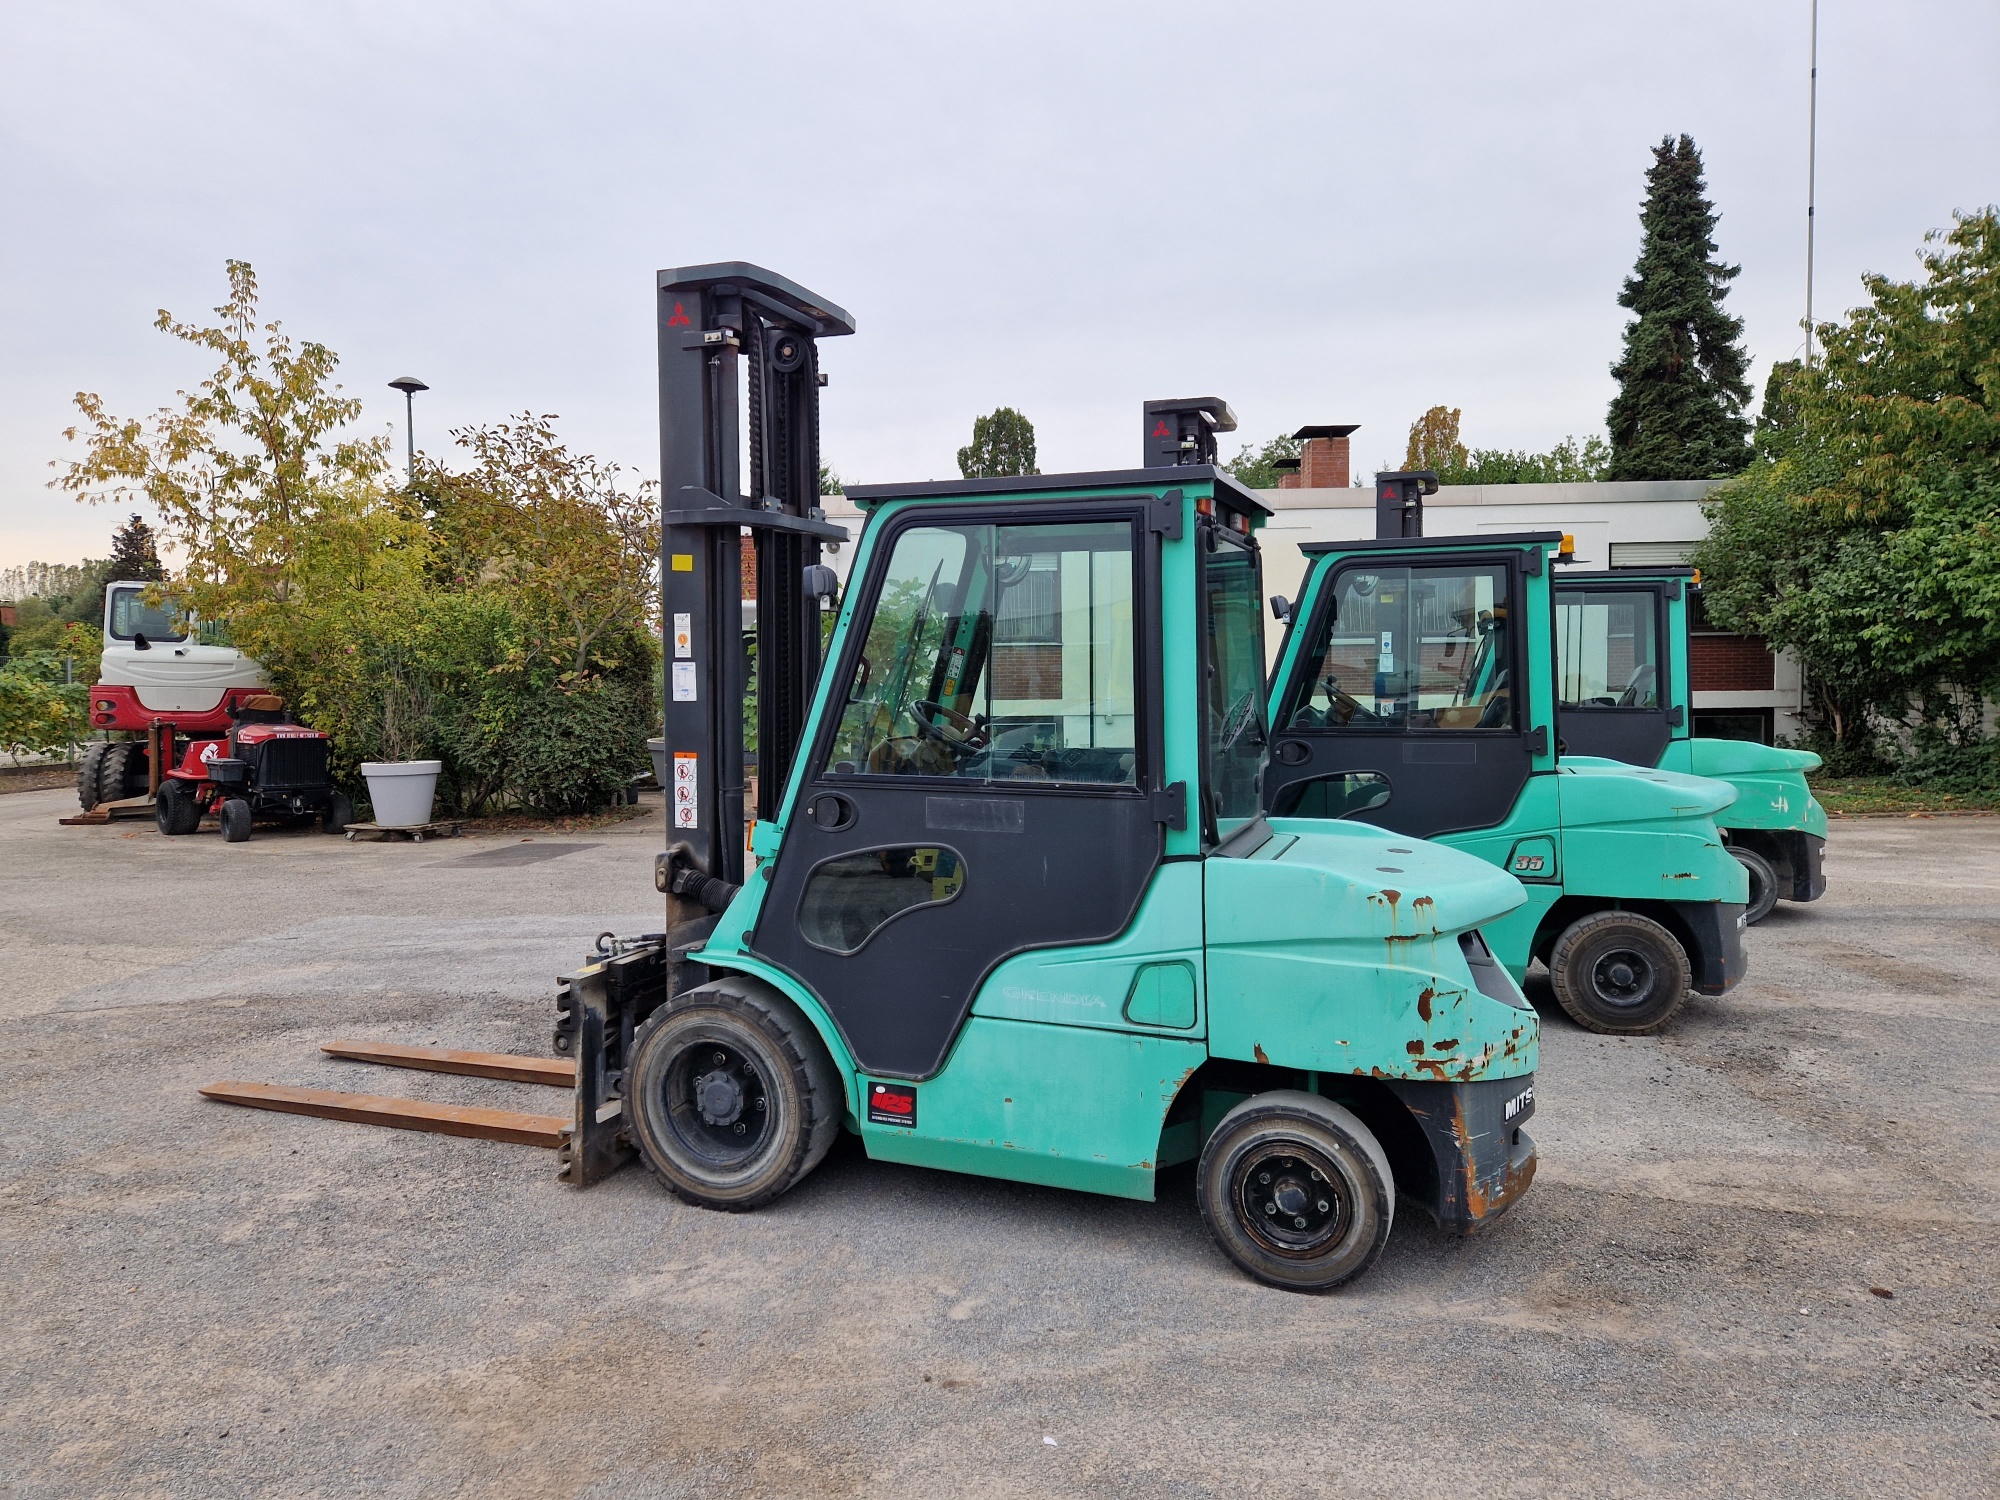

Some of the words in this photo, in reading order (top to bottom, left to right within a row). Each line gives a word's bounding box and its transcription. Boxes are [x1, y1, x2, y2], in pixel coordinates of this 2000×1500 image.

[1515, 855, 1545, 871] 35
[1002, 986, 1106, 1008] GRENDIA
[785, 1079, 797, 1120] SOLIDEAL
[1505, 1086, 1535, 1121] MITS
[1250, 1119, 1305, 1134] SOLIDEAL
